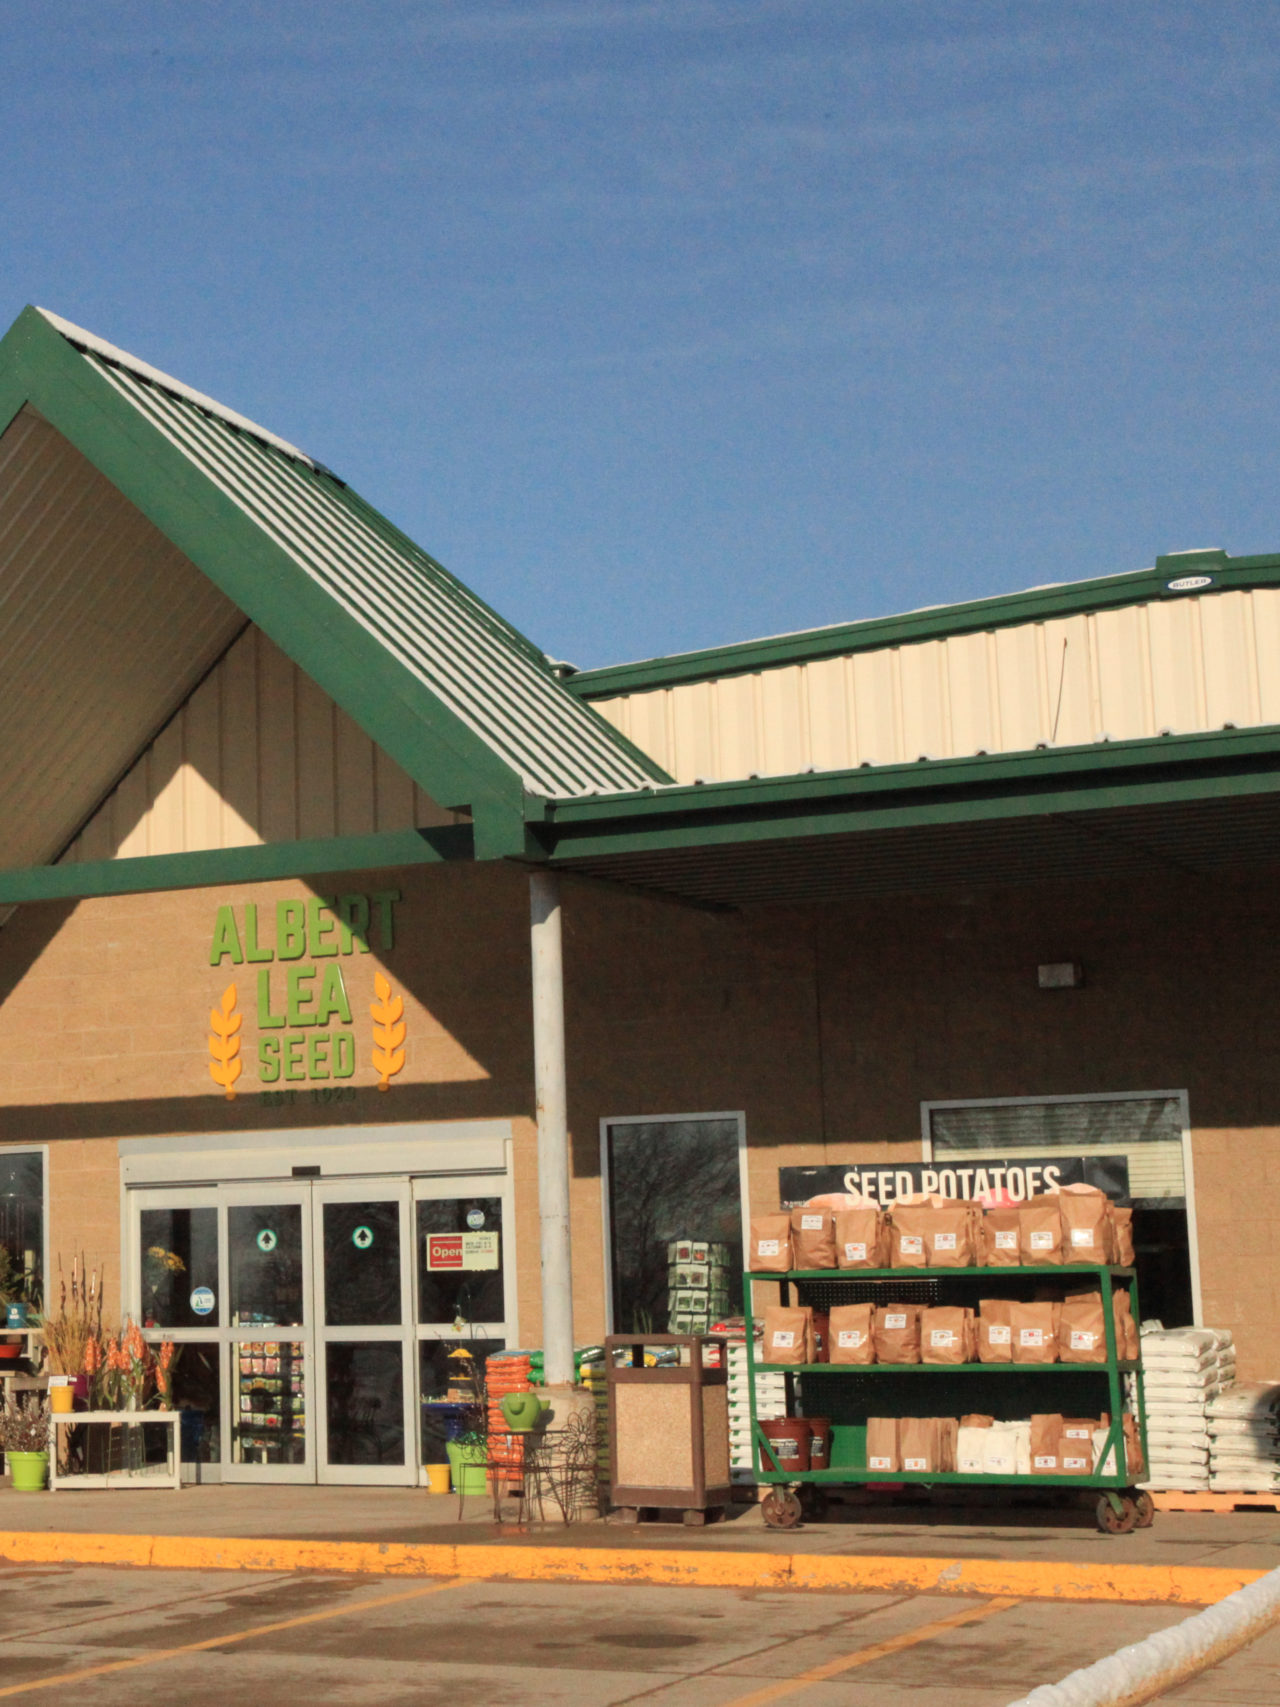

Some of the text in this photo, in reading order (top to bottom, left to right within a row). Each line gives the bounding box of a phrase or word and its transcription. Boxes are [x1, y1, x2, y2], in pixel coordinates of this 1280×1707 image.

[1173, 578, 1207, 588] BUTLER
[210, 890, 401, 966] ALBERT
[257, 963, 353, 1029] LEA
[258, 1032, 355, 1082] SEED
[844, 1165, 1062, 1206] SEED POTATOES
[433, 1247, 462, 1258] Open
